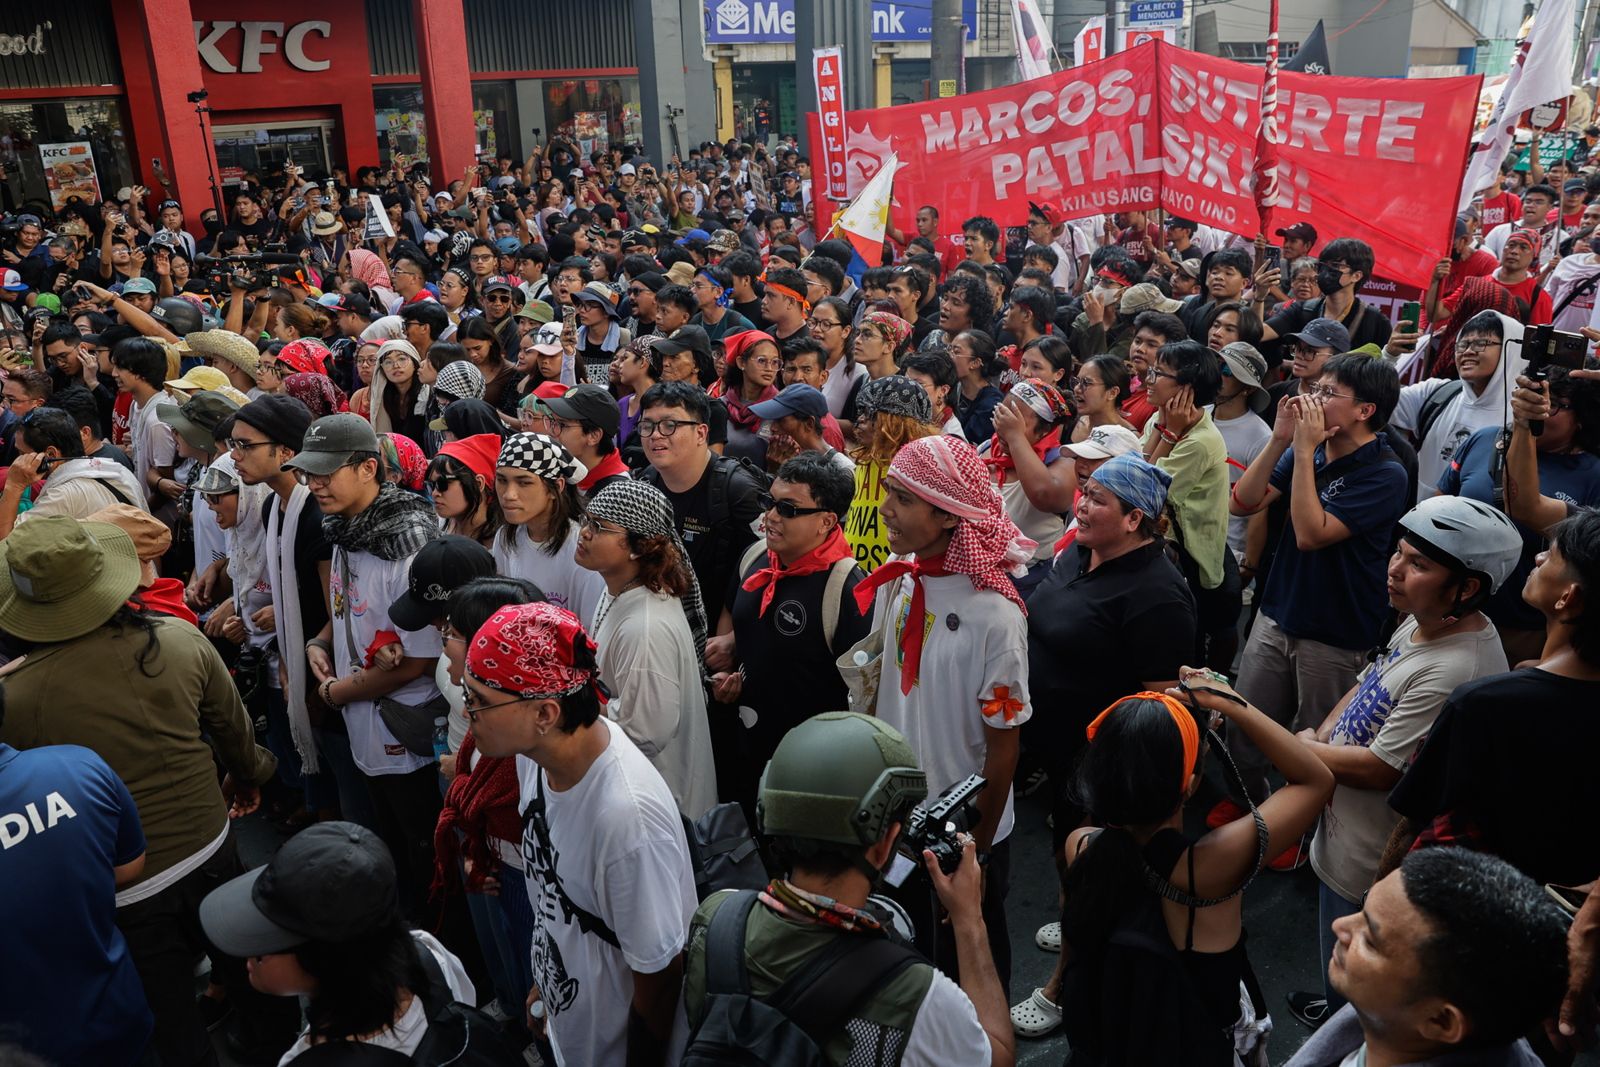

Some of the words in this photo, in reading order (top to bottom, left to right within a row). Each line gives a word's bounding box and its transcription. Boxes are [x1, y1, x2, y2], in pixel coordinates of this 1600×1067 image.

[1137, 9, 1175, 20] MENDIOLA
[1153, 2, 1176, 10] RECTO
[192, 20, 331, 73] KFC
[921, 69, 1151, 154] MARCOS,
[1170, 64, 1424, 162] DUTERTE
[42, 148, 67, 158] KFC
[1062, 185, 1154, 212] KILUSANG
[1161, 185, 1194, 212] MAYO
[1200, 199, 1236, 224] UNO
[0, 791, 78, 850] DIA
